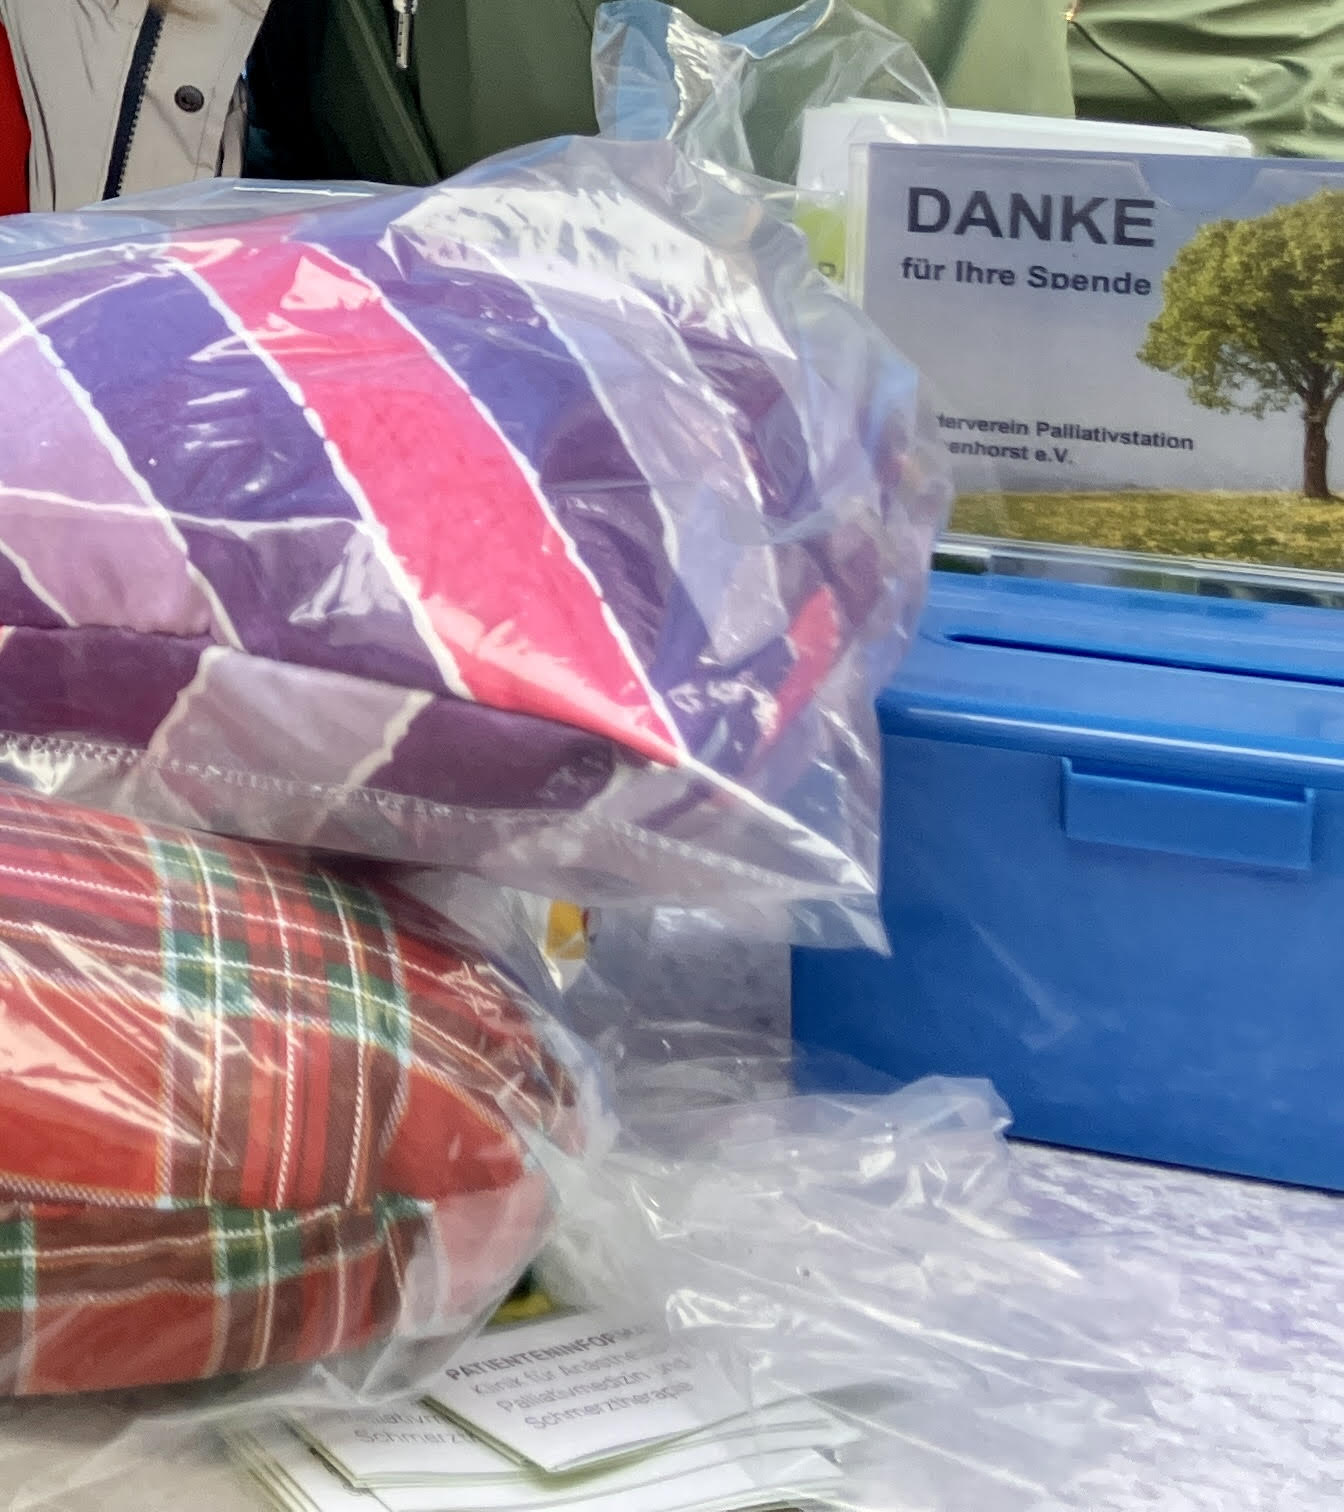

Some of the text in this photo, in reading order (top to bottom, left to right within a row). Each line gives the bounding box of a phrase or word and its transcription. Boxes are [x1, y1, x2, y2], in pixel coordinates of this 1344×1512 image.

[907, 186, 1156, 248] DANKE
[900, 257, 1152, 296] für Ihre Spende
[1036, 421, 1194, 451] Palliativstation
[1035, 445, 1076, 467] e.V.
[558, 1349, 644, 1377] Anästhe
[496, 1369, 653, 1414] Palliativmedizin
[523, 1381, 694, 1430] Schmerztherapie
